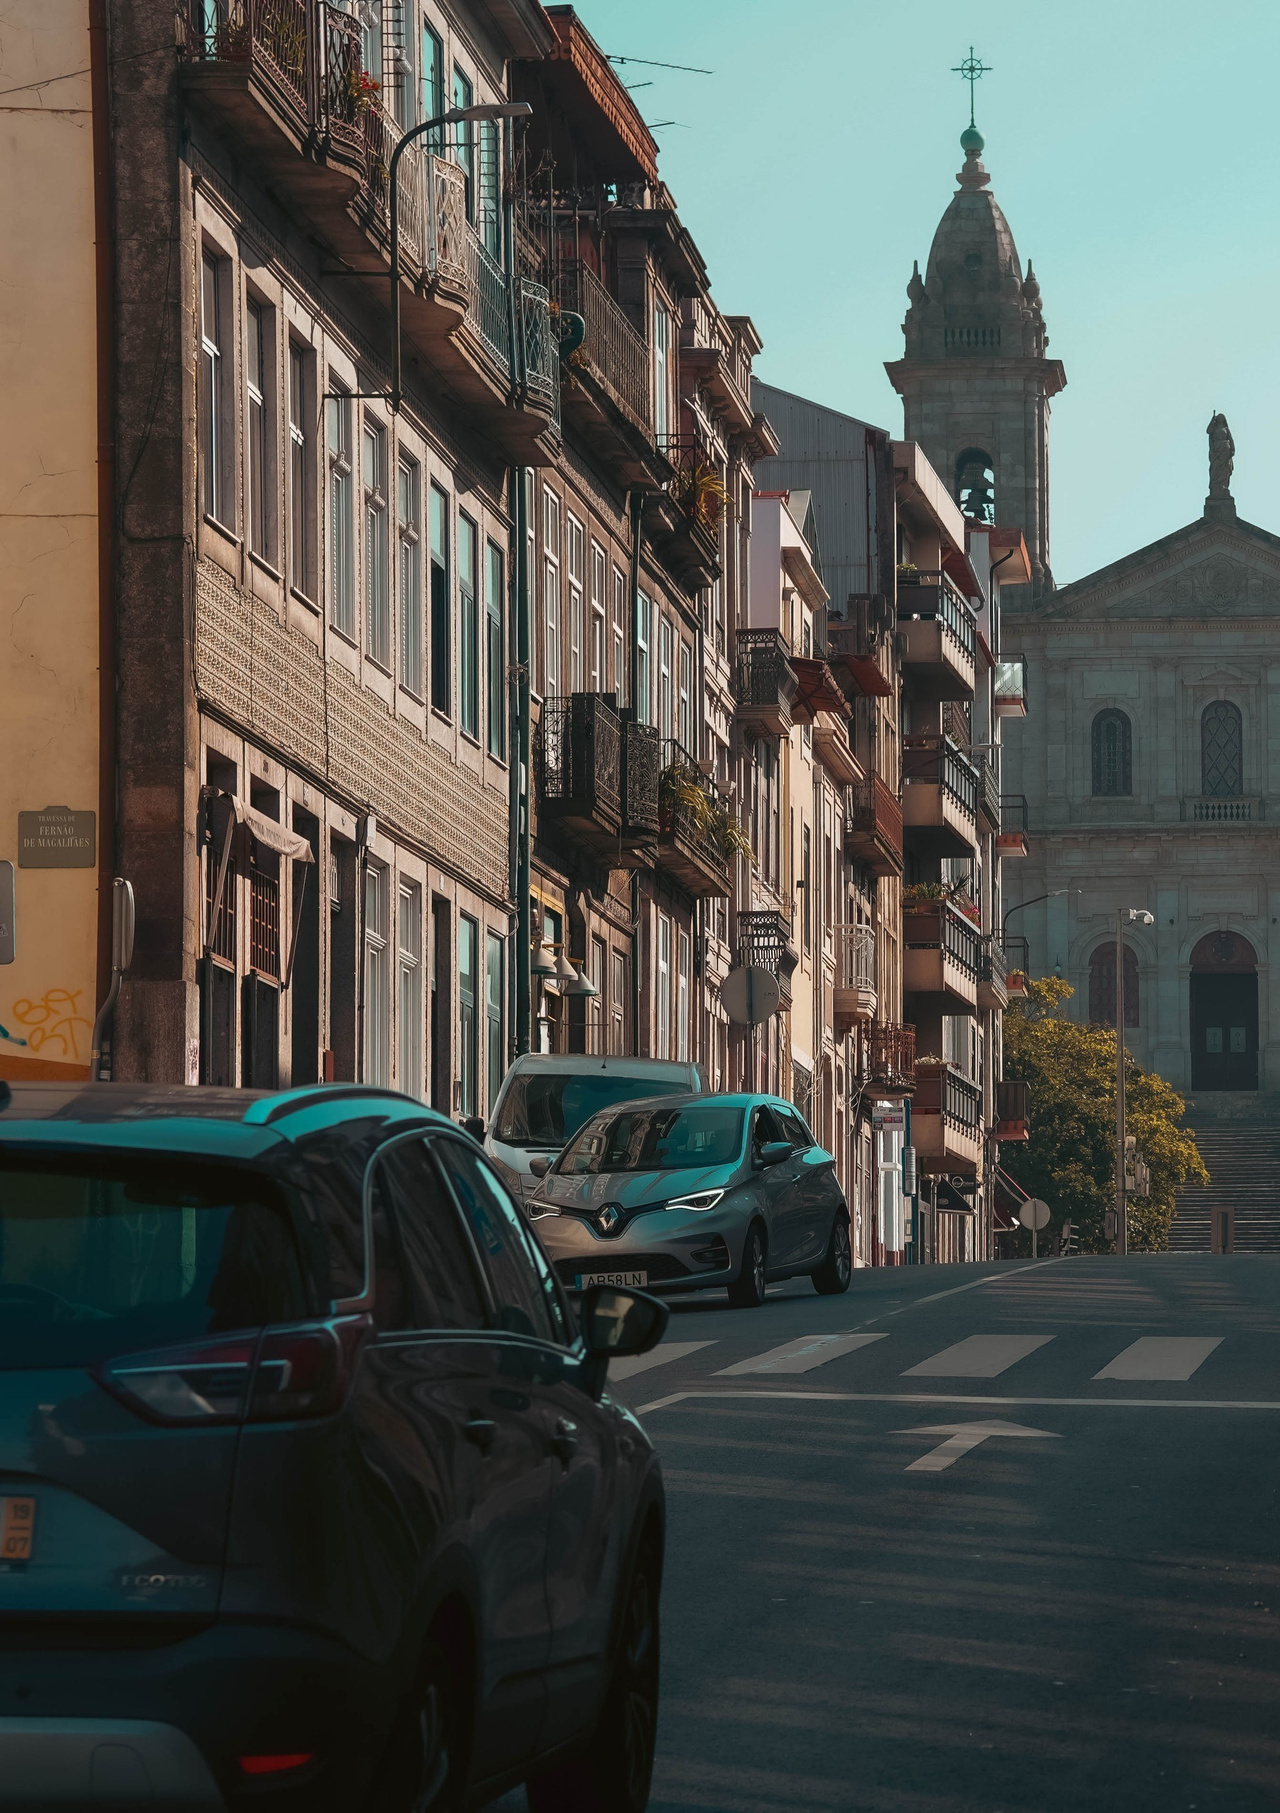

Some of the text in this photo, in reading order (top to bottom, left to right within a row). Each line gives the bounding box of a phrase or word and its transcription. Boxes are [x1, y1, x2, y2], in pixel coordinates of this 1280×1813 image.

[39, 825, 74, 836] FERNÃO
[23, 836, 90, 848] DE MAGALHÃES
[13, 1504, 30, 1519] 19
[6, 1537, 28, 1552] 07
